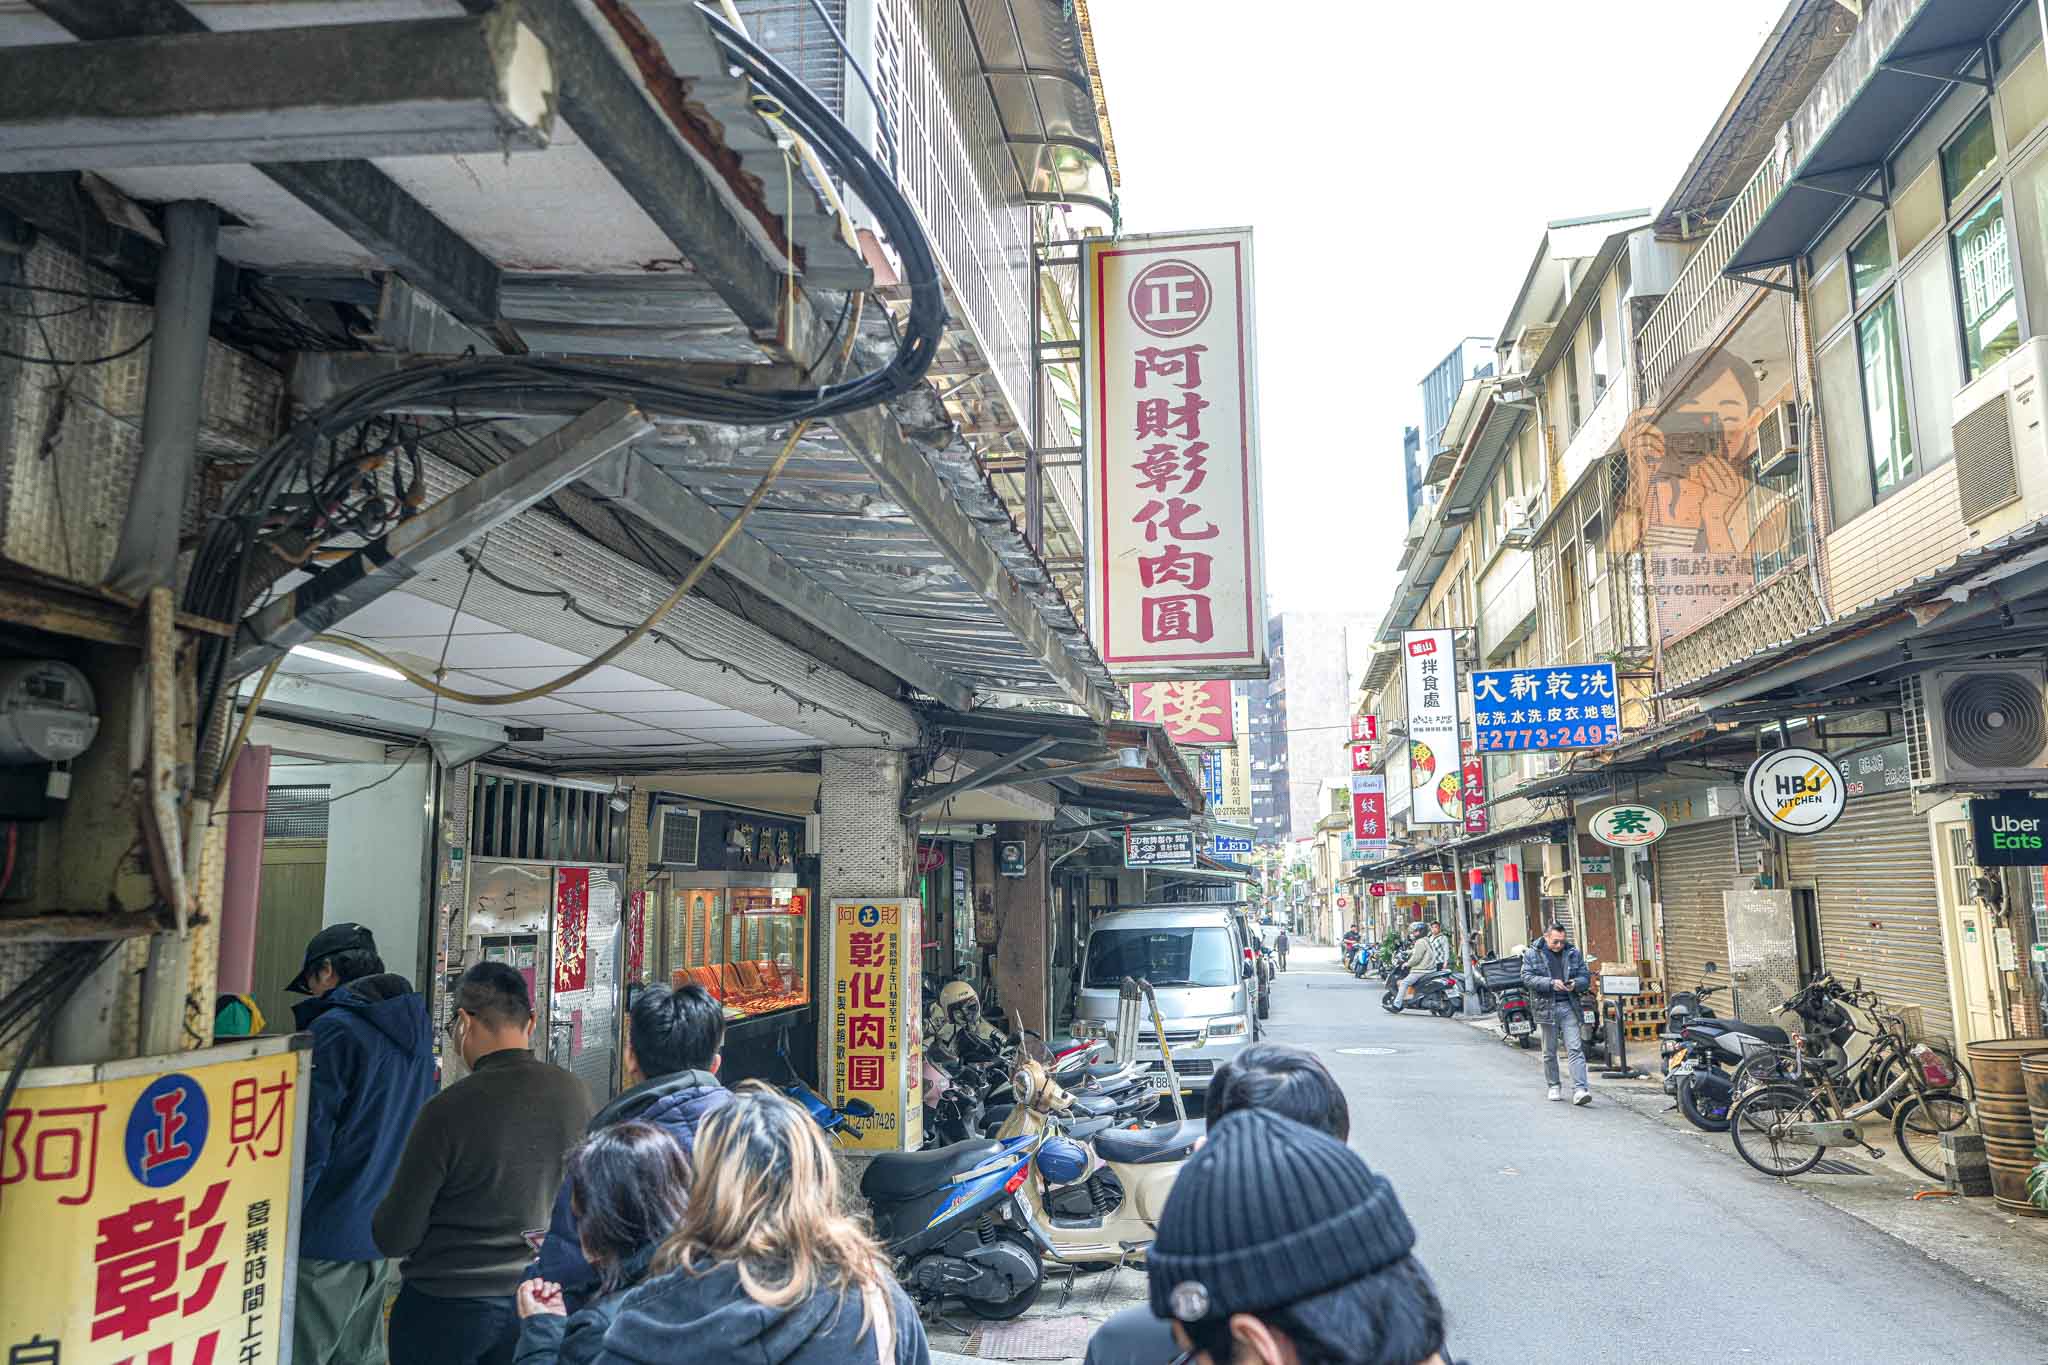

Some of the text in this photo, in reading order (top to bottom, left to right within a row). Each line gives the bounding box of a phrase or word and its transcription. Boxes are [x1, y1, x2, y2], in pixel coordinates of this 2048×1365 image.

[1143, 274, 1197, 322] 正
[1132, 343, 1219, 643] 阿財彰化肉圓
[1421, 658, 1440, 708] 拌食處
[1474, 670, 1614, 703] 大新乾洗
[1775, 775, 1821, 795] HBJ
[1777, 795, 1823, 809] KITCHEN
[1608, 809, 1651, 835] 素
[1991, 815, 2040, 832] Uber
[1218, 841, 1250, 851] LED
[1993, 833, 2042, 849] Eats
[1588, 864, 1602, 873] 22
[848, 931, 886, 1090] 彰化肉圓
